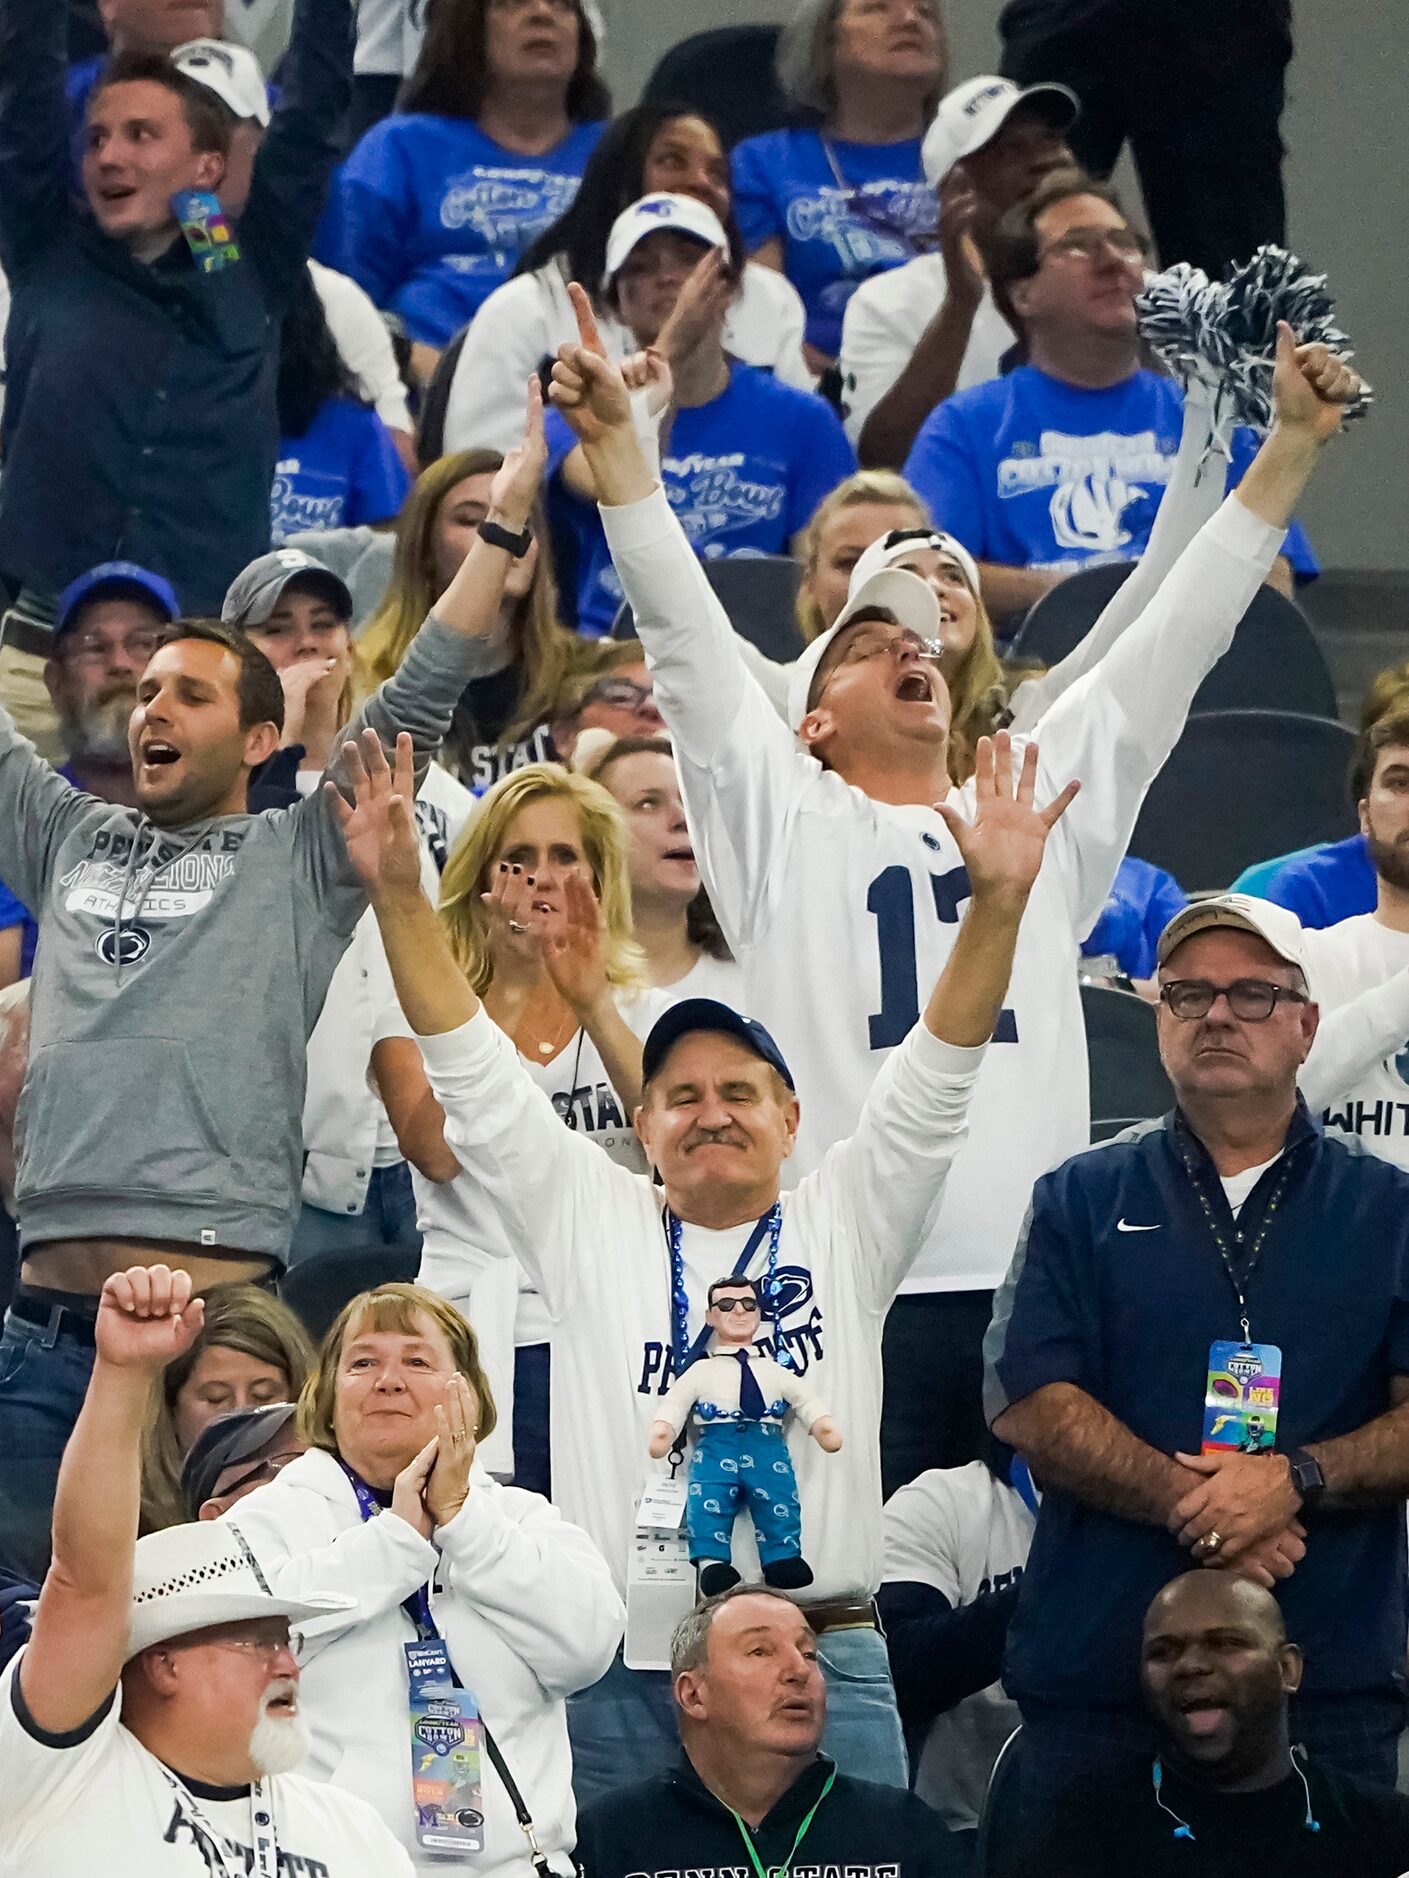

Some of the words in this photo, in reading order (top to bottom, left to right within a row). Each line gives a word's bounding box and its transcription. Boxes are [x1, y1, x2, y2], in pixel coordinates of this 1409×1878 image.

[85, 894, 186, 914] ATHICS
[408, 1657, 447, 1668] LANYARD
[418, 1726, 462, 1741] COTTON
